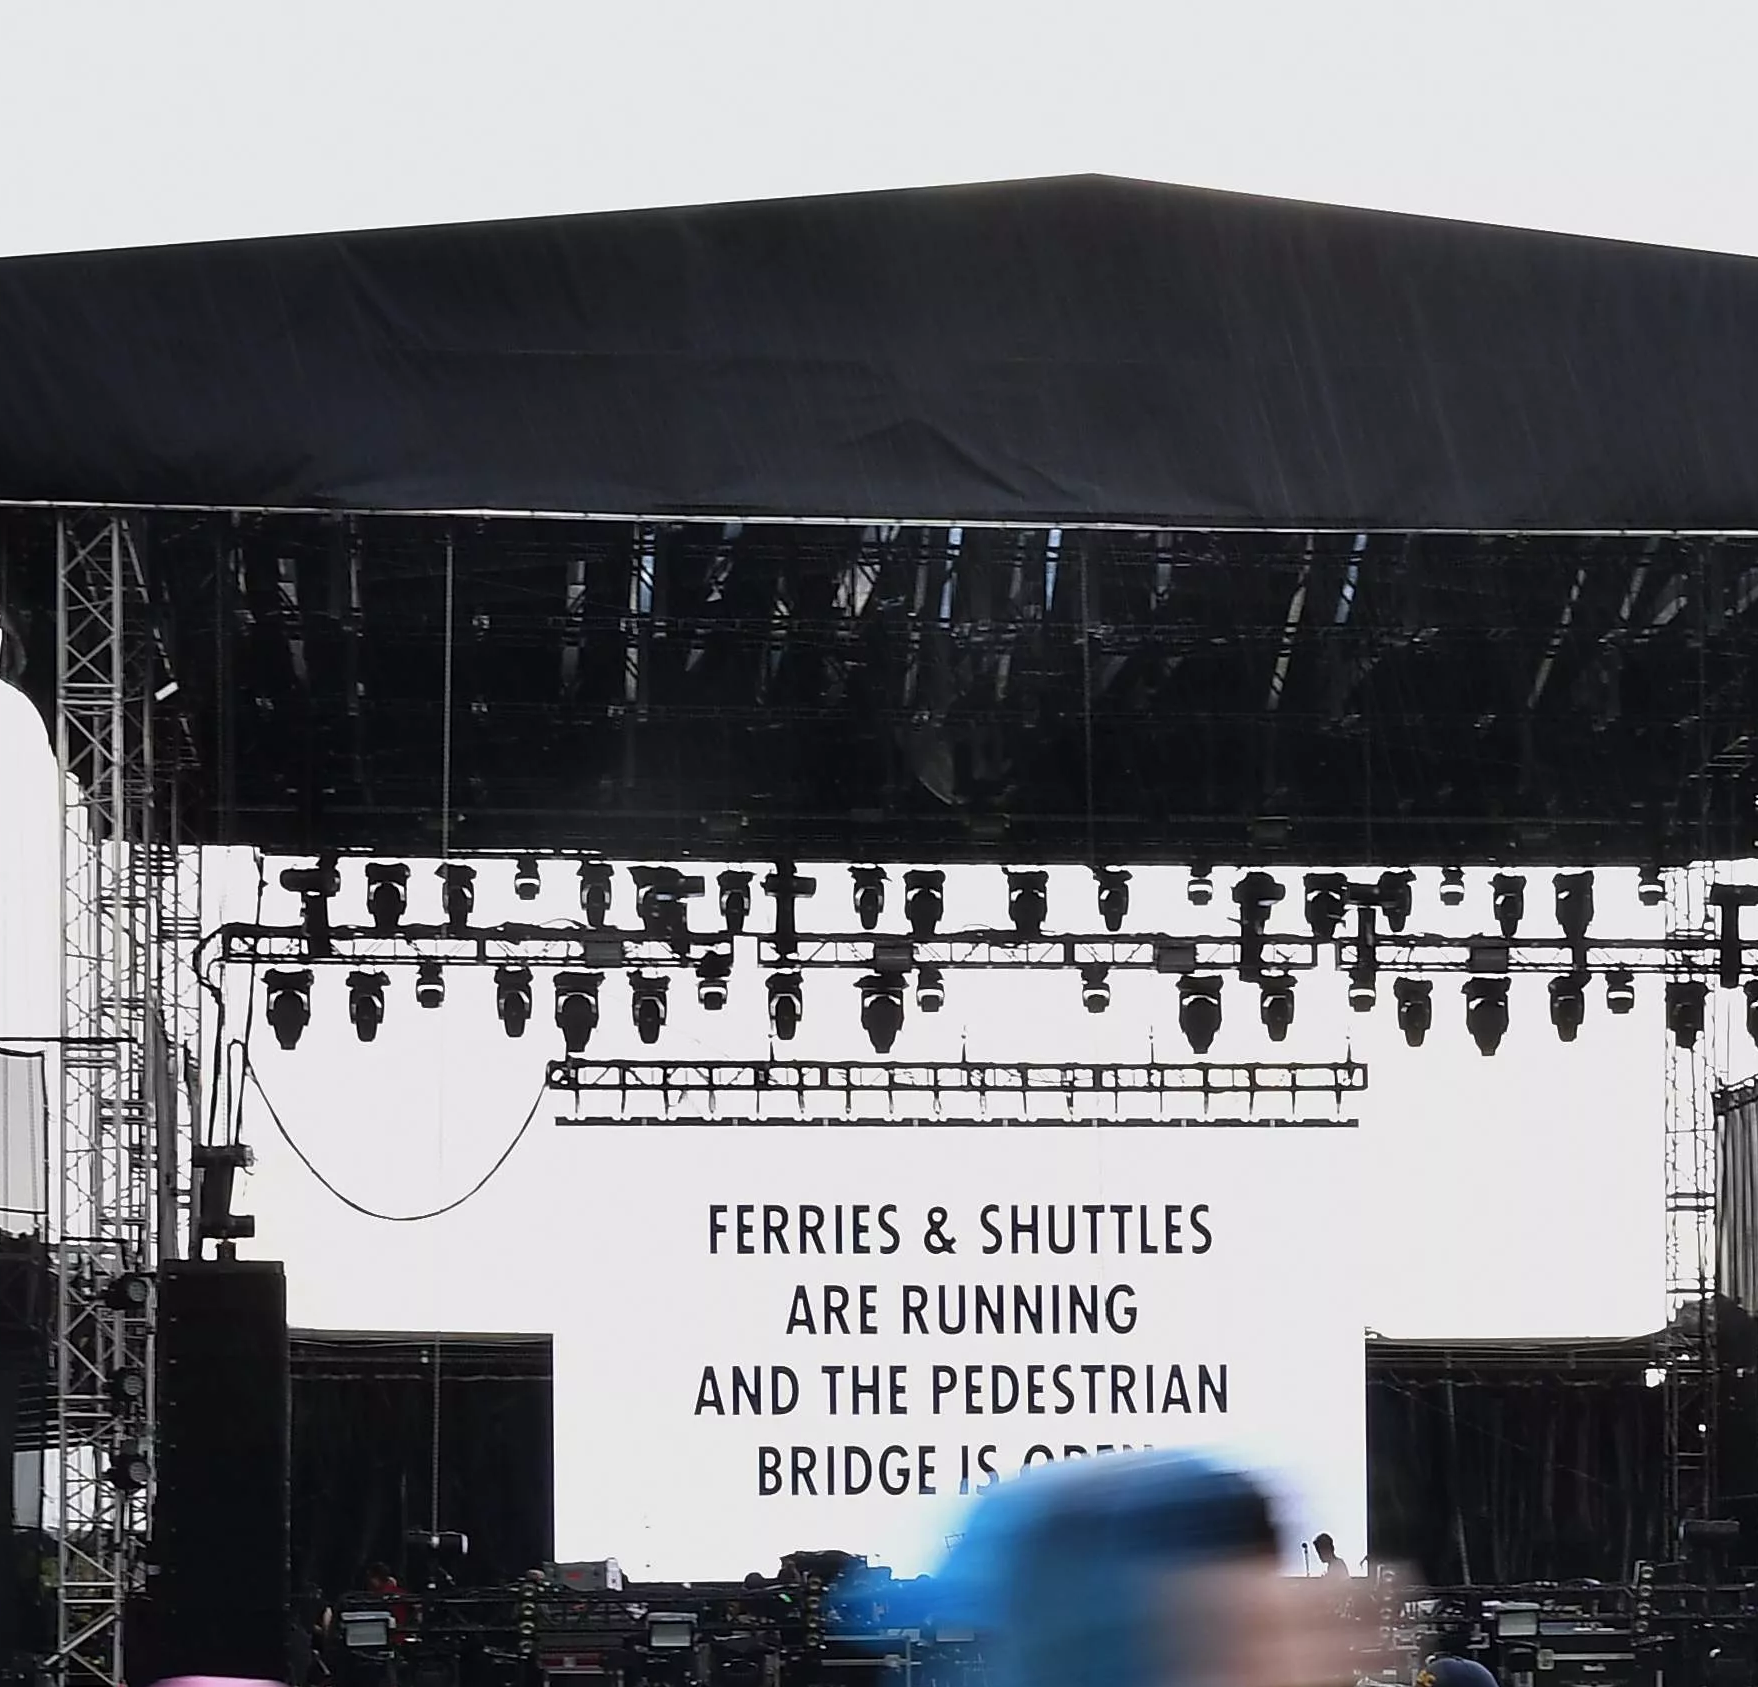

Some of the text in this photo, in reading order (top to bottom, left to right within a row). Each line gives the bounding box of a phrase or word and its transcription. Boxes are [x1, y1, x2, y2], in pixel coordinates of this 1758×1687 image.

[709, 1204, 1212, 1254] FERRIES & SHUTTLES
[786, 1284, 1137, 1335] ARE RUNNING
[694, 1364, 1227, 1415] AND THE PEDESTRIAN
[758, 1445, 936, 1496] BRIDGE
[959, 1445, 1000, 1496] IS
